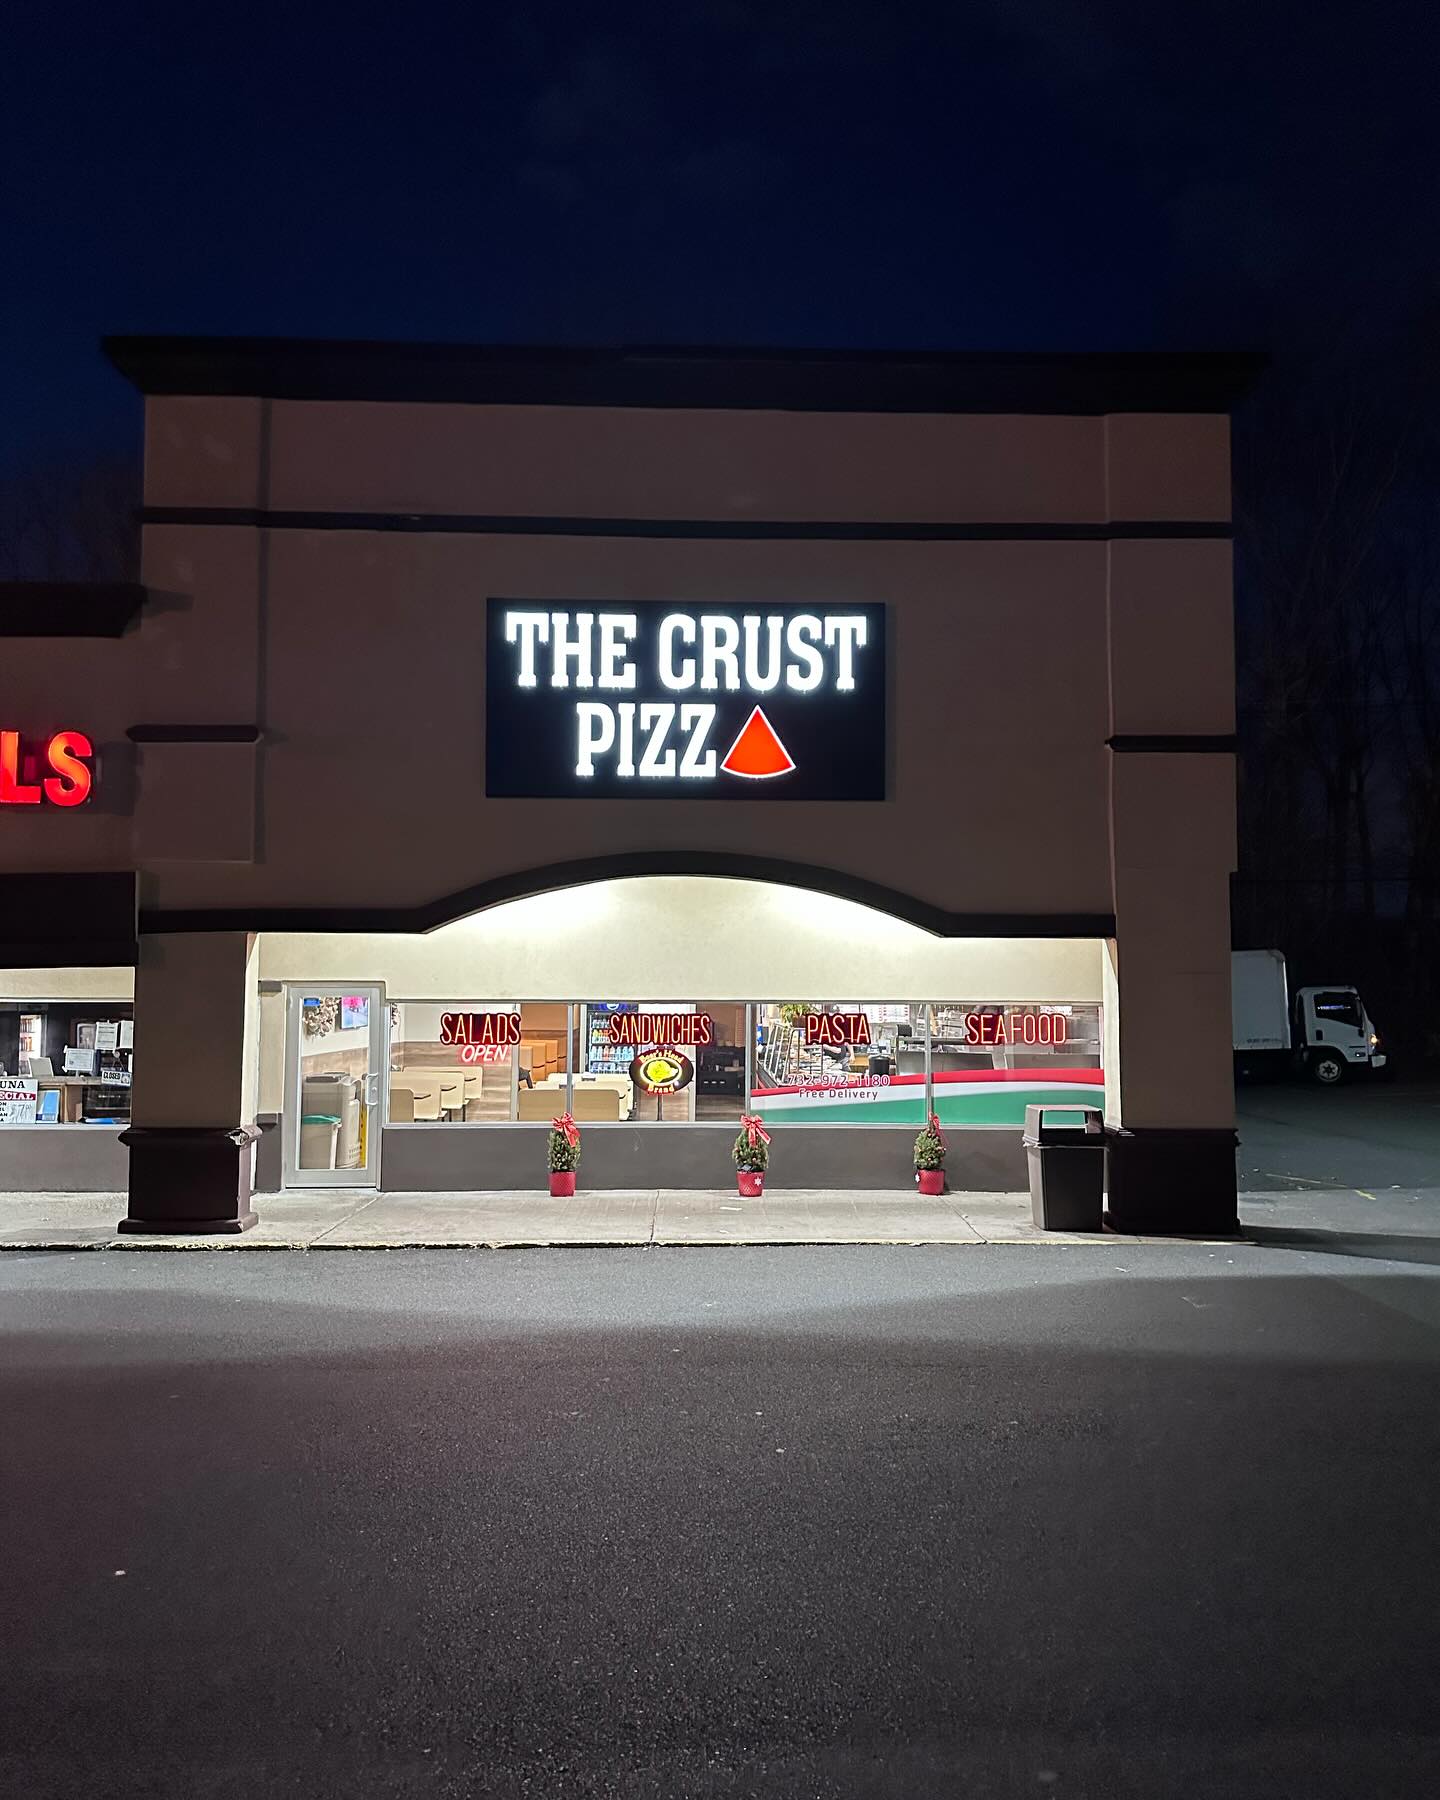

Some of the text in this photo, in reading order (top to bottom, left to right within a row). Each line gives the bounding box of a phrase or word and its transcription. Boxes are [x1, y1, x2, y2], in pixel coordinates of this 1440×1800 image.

[506, 611, 867, 692] THE CRUST
[0, 731, 92, 806] LS
[440, 1012, 521, 1045] SALADS
[609, 1013, 712, 1045] SANDWICHES
[806, 1013, 871, 1045] PASTA
[965, 1013, 1067, 1045] SEAFOOD
[461, 1044, 508, 1063] OPEN
[663, 1049, 684, 1064] Head
[0, 1080, 25, 1089] UNA
[103, 1071, 121, 1080] CLOSED
[787, 1074, 890, 1087] 732-972-1180
[647, 1083, 675, 1094] Brand
[799, 1089, 878, 1100] Free Delivery
